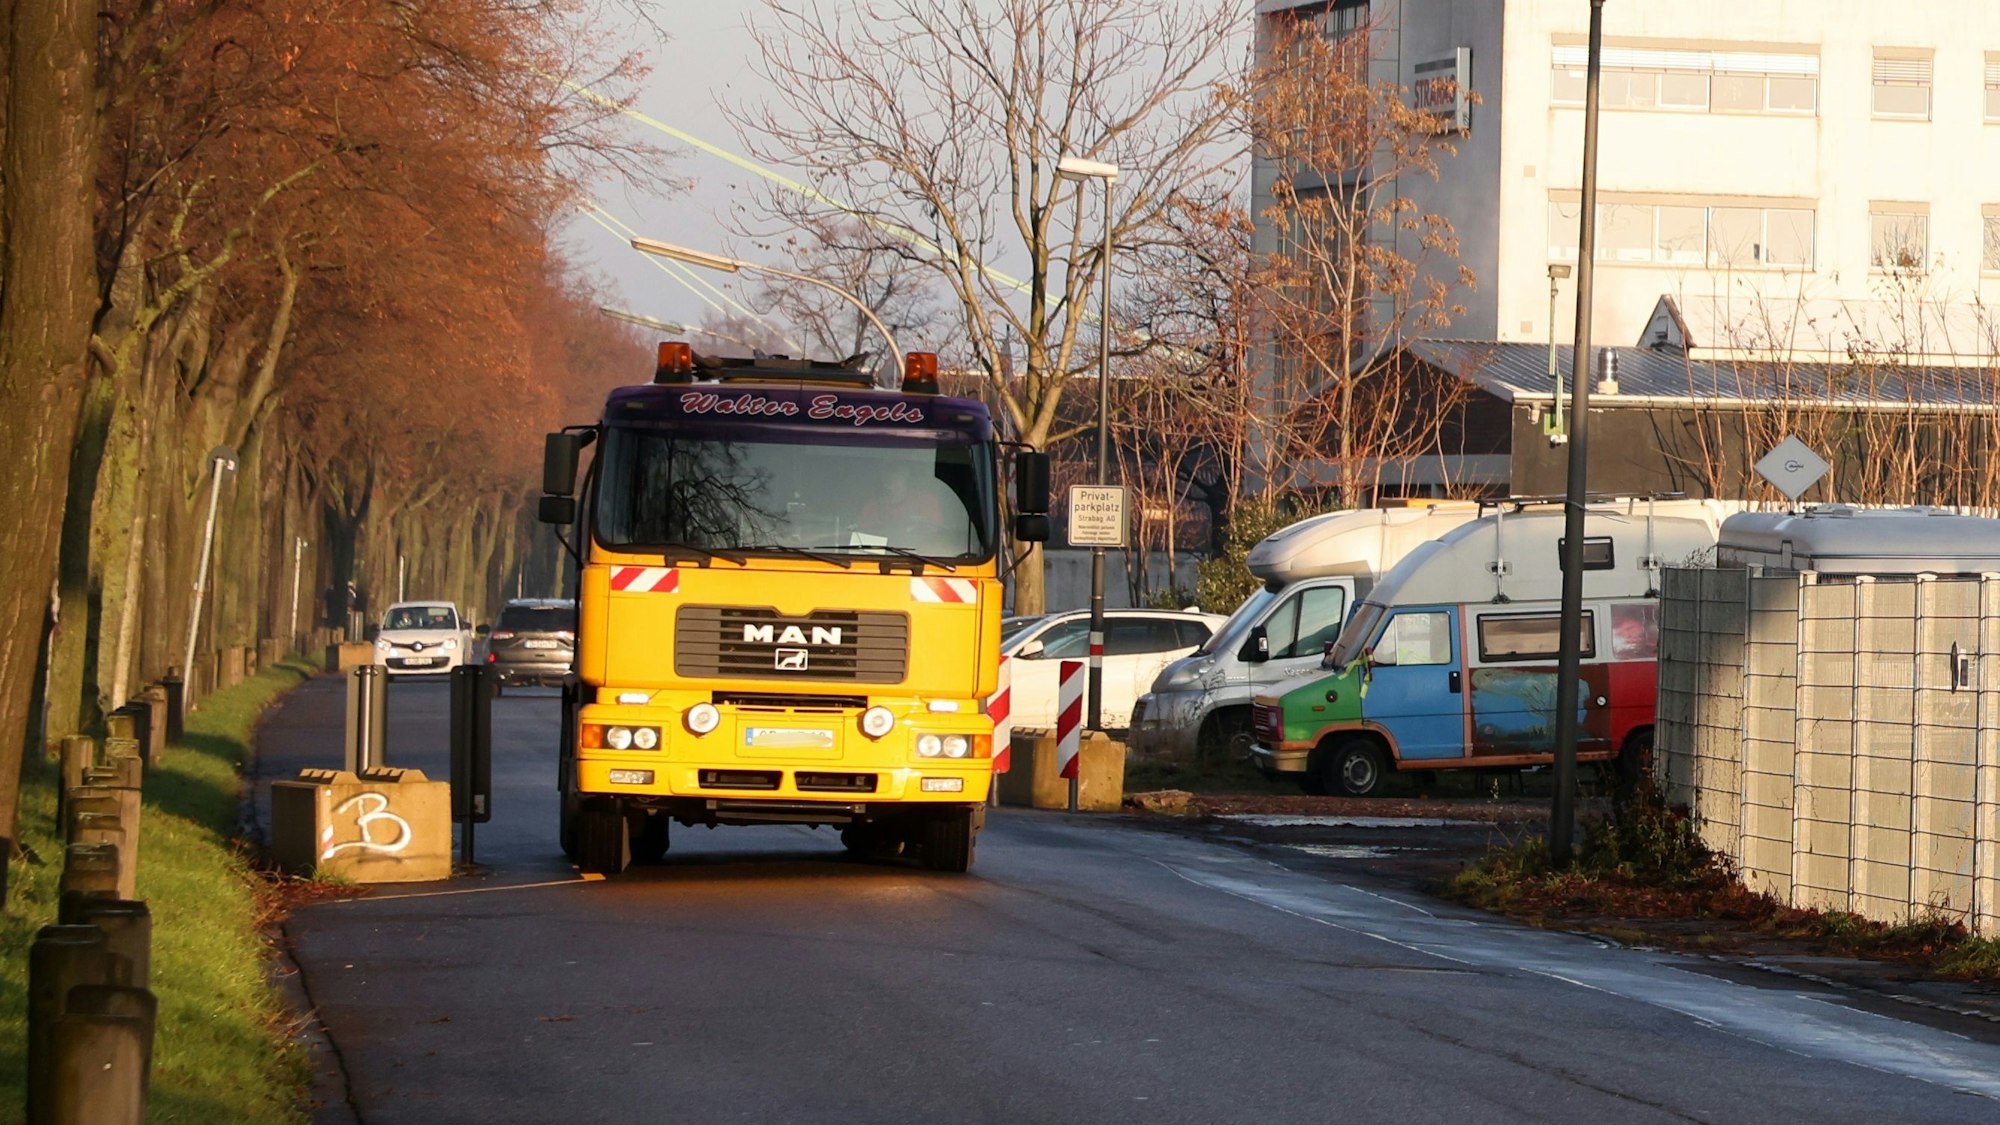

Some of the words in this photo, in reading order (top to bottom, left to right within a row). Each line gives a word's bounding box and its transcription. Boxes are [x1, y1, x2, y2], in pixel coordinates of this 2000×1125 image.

[680, 392, 799, 415] Walter
[808, 395, 924, 426] Engels
[1080, 491, 1115, 501] Privat-
[1074, 502, 1120, 513] parkplatz
[743, 624, 842, 645] MAN
